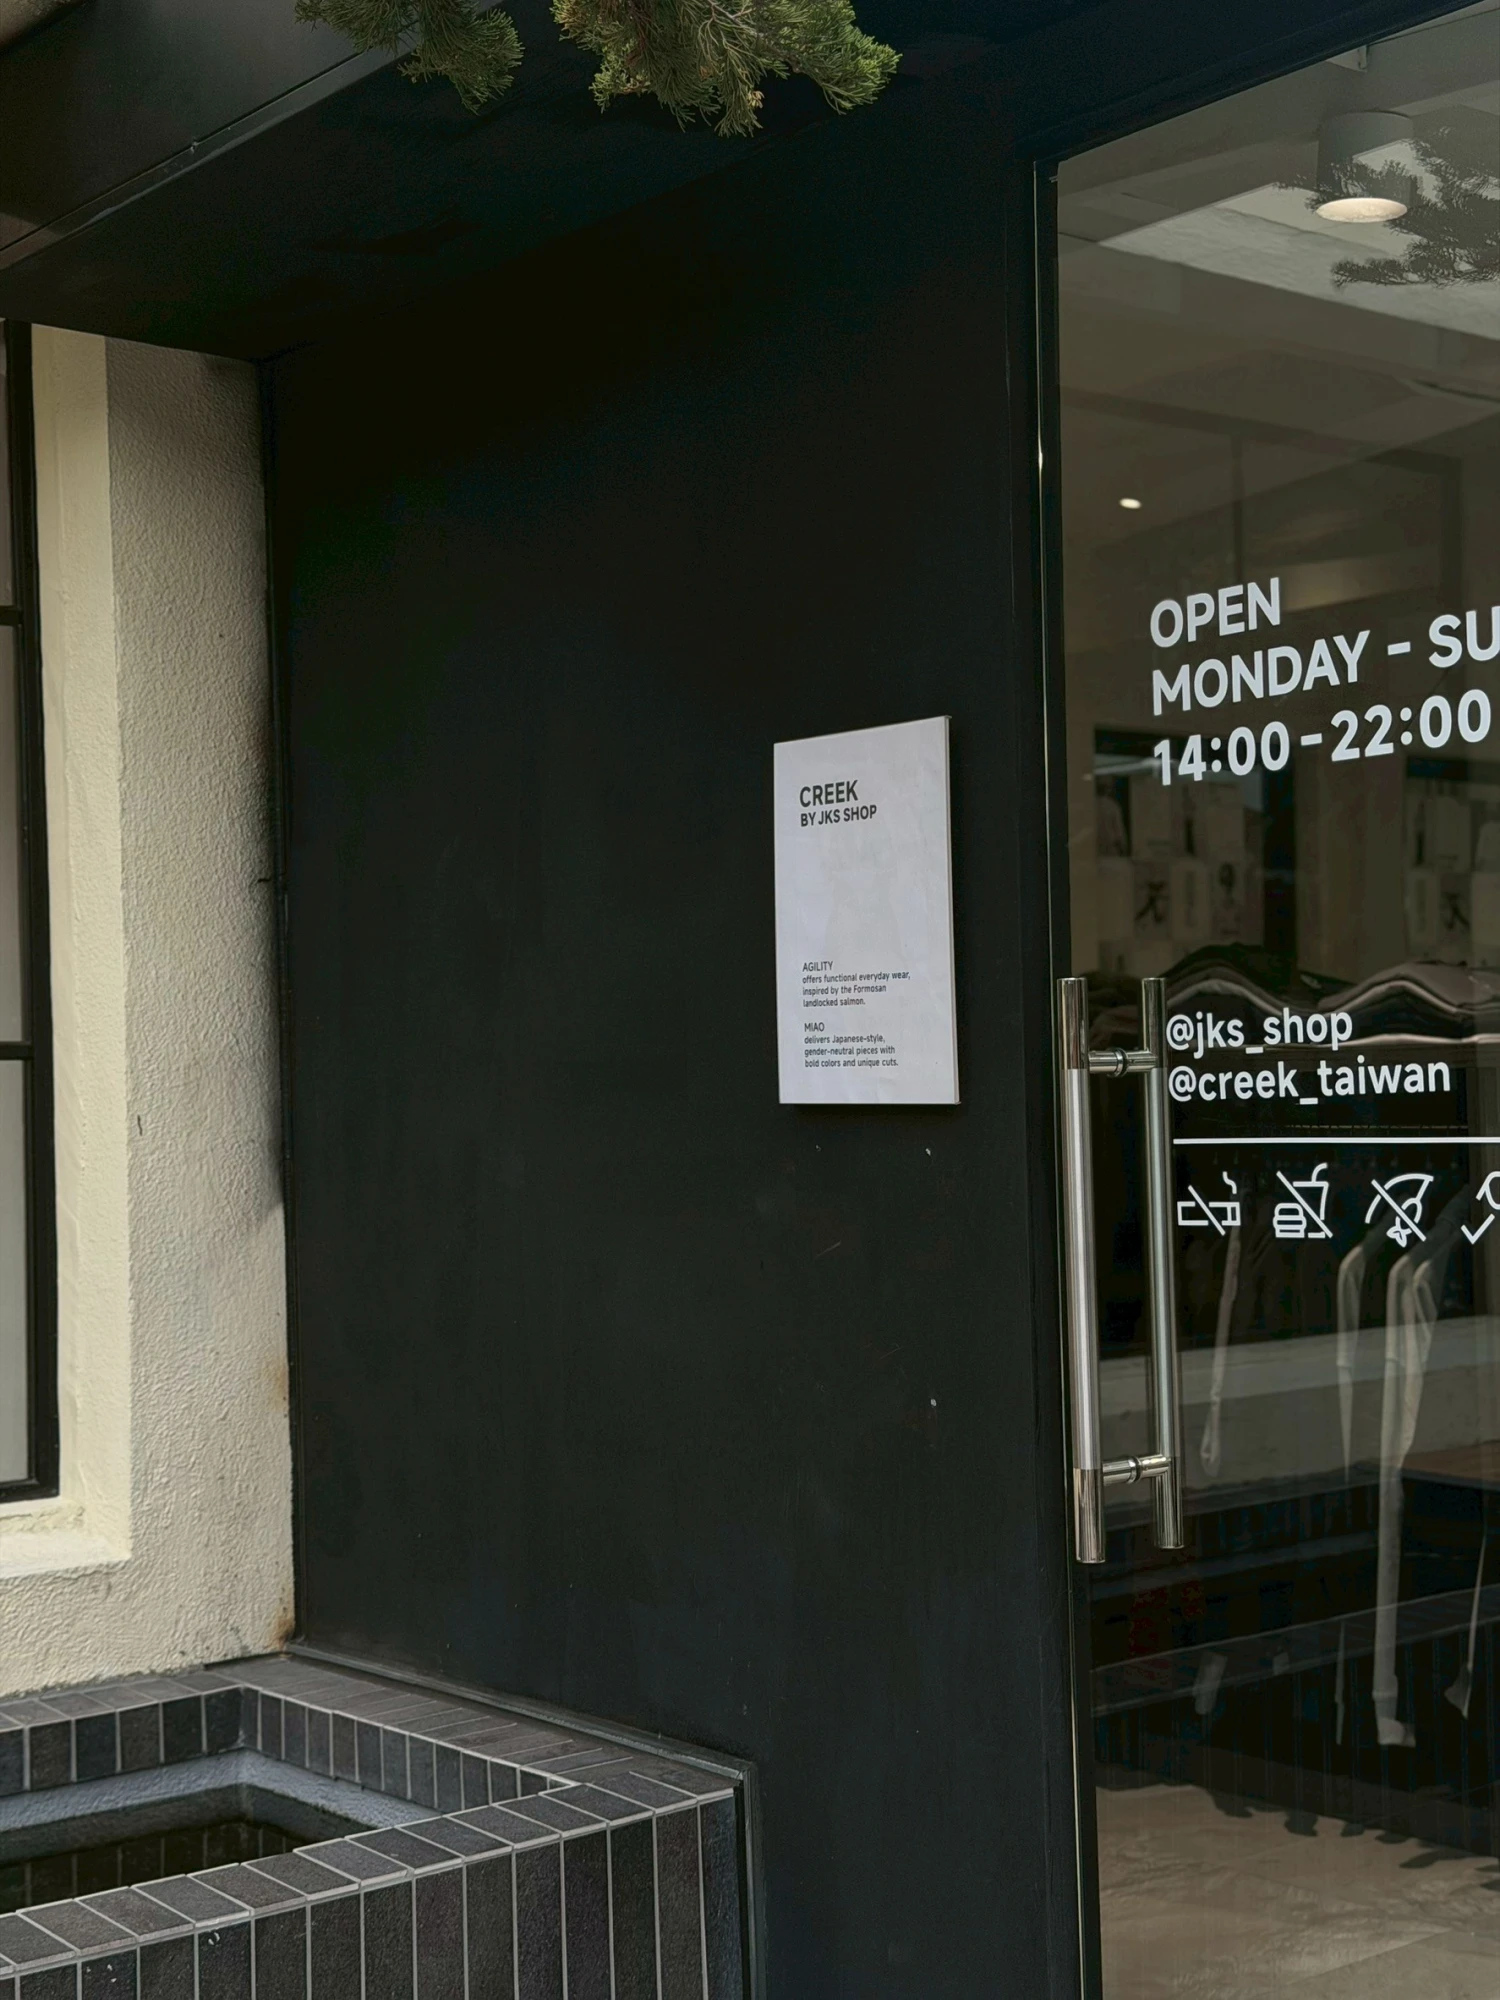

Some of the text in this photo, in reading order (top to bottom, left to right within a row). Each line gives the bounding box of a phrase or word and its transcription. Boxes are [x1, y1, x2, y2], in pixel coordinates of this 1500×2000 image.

[1150, 577, 1281, 648] OPEN
[1152, 630, 1370, 716] MONDAY
[799, 779, 859, 808] CREEK
[800, 804, 877, 828] BY JKS SHOP
[802, 961, 833, 972] AGILITY
[802, 971, 911, 984] offers functional everyday wear,
[802, 984, 887, 997] inspired by the Formosan
[802, 997, 866, 1008] landlocked salmon.
[804, 1022, 825, 1033] MIAO
[1166, 1007, 1352, 1059] @jks_shop
[804, 1033, 886, 1045] delivers Japanese-style,
[804, 1045, 896, 1058] gender-neutral pieces with
[804, 1058, 899, 1069] bold colors and unique cuts.
[1168, 1054, 1451, 1105] @creek_taiwan
